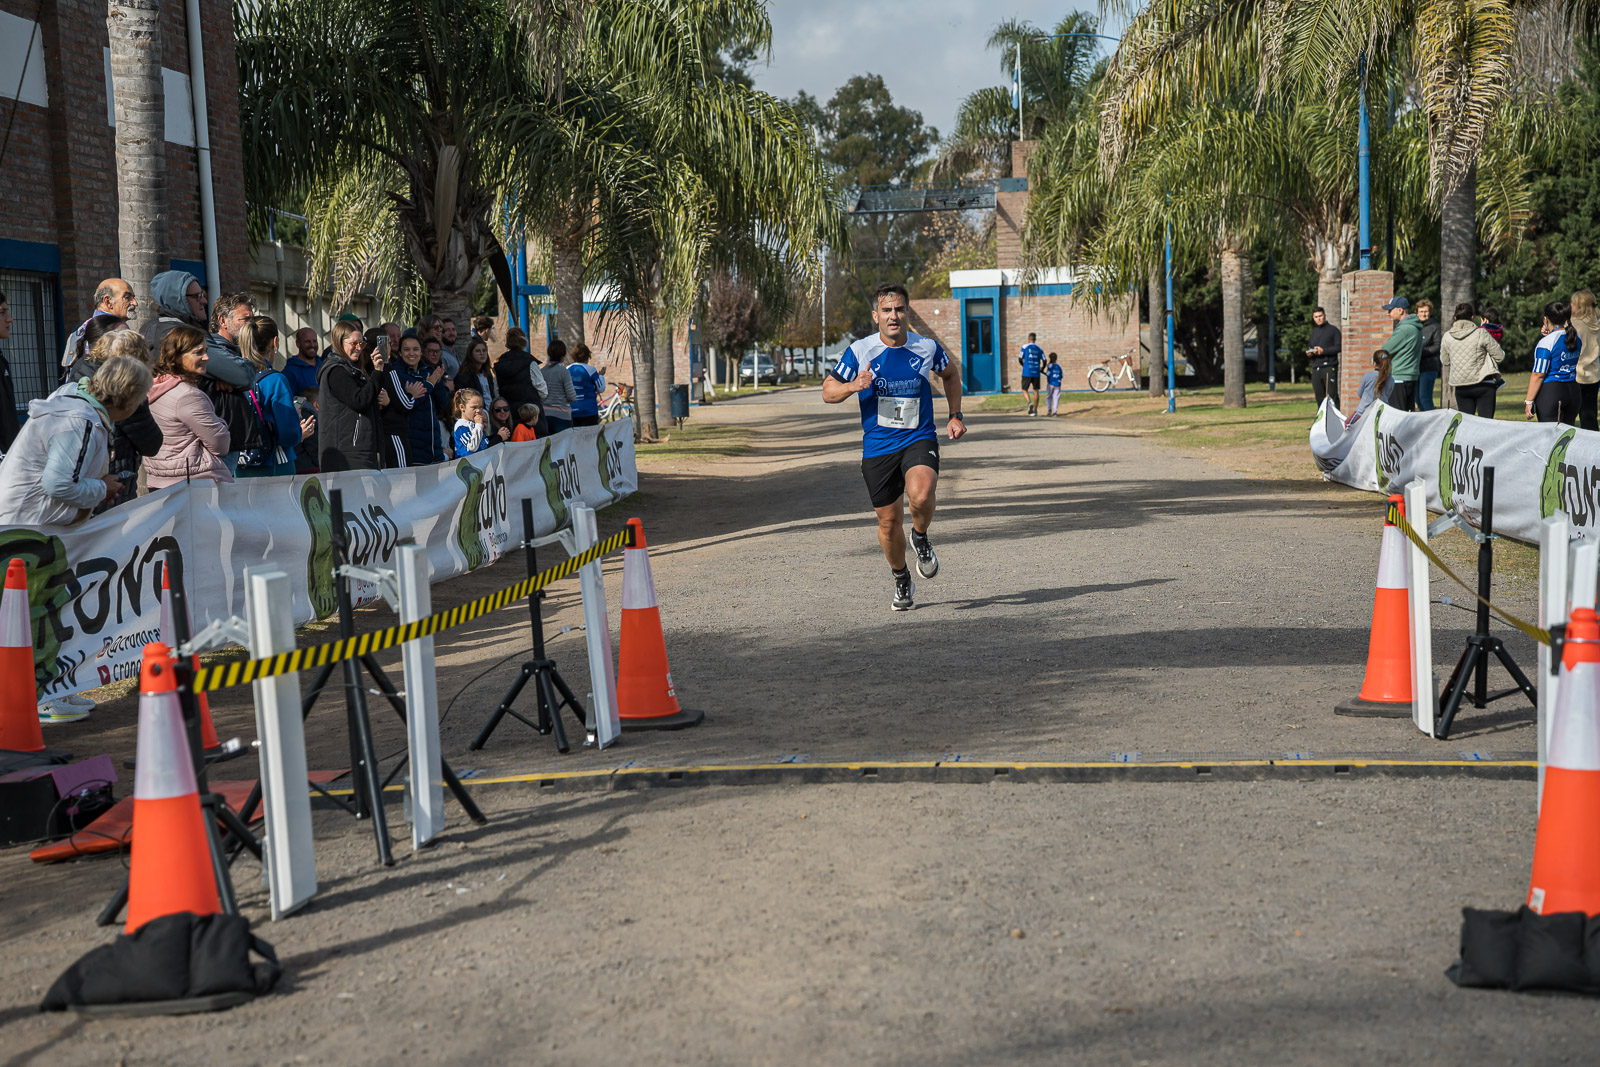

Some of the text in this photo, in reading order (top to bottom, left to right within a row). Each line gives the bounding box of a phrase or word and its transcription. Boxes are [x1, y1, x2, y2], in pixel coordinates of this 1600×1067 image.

[875, 378, 887, 397] 3
[894, 406, 903, 421] 1
[113, 658, 142, 682] crono
